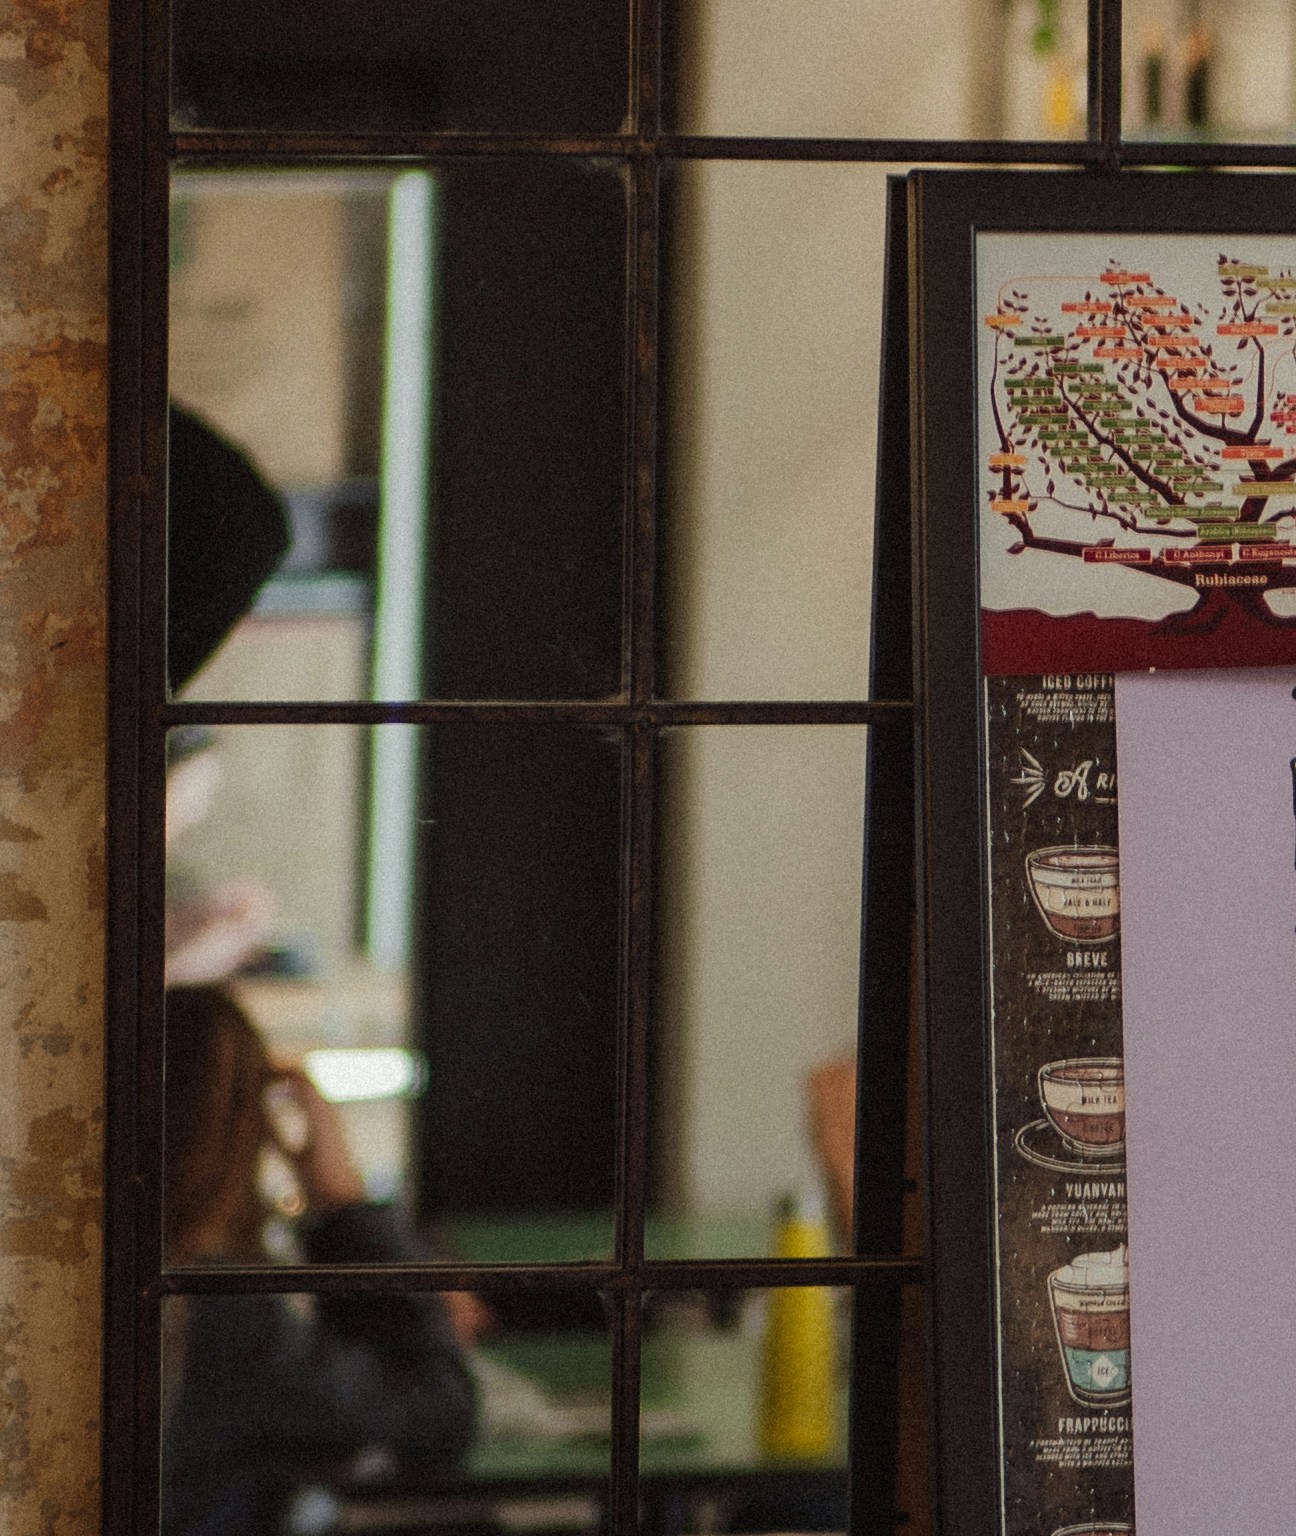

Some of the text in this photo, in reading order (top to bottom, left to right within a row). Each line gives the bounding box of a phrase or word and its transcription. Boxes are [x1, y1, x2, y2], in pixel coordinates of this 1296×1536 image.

[1195, 572, 1269, 586] Rubiaceae
[1042, 674, 1072, 691] ICED
[1066, 951, 1108, 967] BREVE
